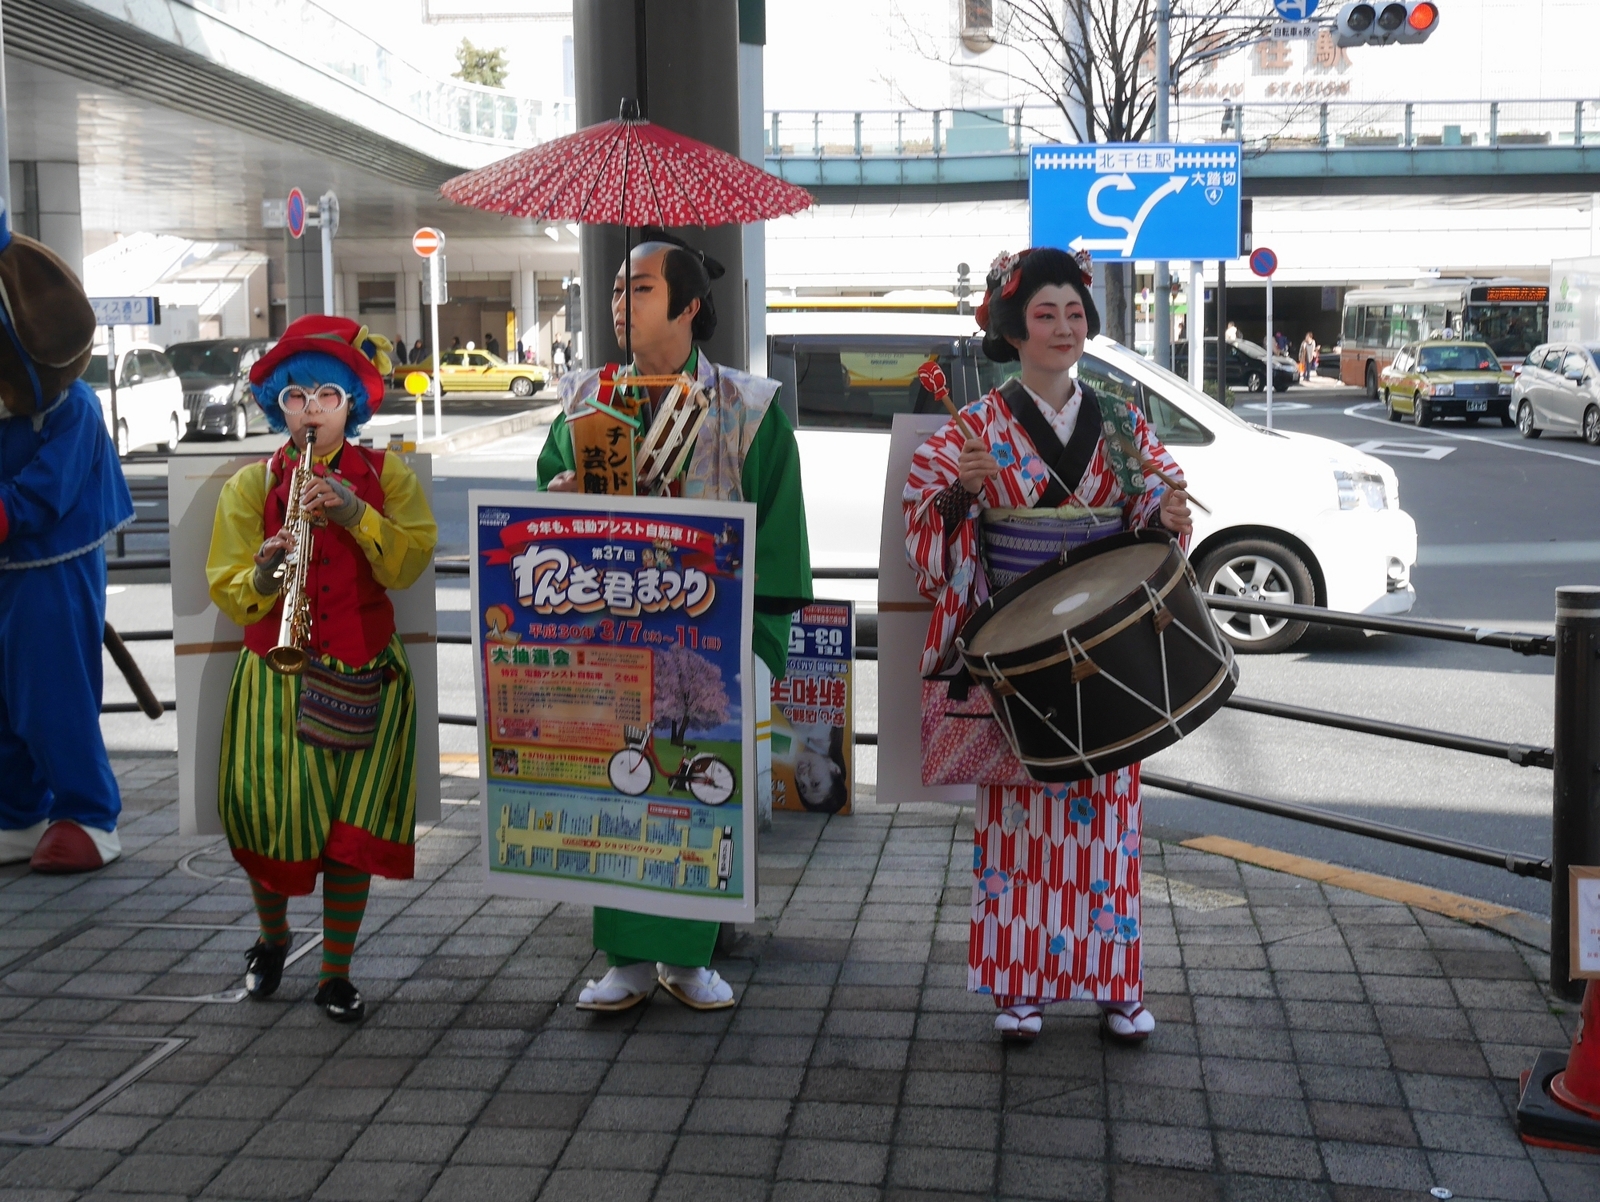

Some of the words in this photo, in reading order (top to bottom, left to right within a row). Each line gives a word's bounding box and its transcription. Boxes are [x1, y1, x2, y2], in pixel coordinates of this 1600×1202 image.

[1273, 26, 1317, 38] 自転車を除く
[1099, 151, 1173, 169] 北千住駅
[1191, 171, 1236, 187] 大踏切
[1208, 190, 1218, 201] 4
[591, 544, 635, 563] 第37回
[512, 545, 711, 612] わんさ君まつり
[529, 622, 595, 640] 平成30年
[491, 646, 571, 667] 大抽選会
[817, 644, 844, 656] TEL
[524, 669, 604, 680] 電動アシスト自転車
[816, 660, 848, 674] 営業時間
[604, 841, 663, 856] ショッピングマップ
